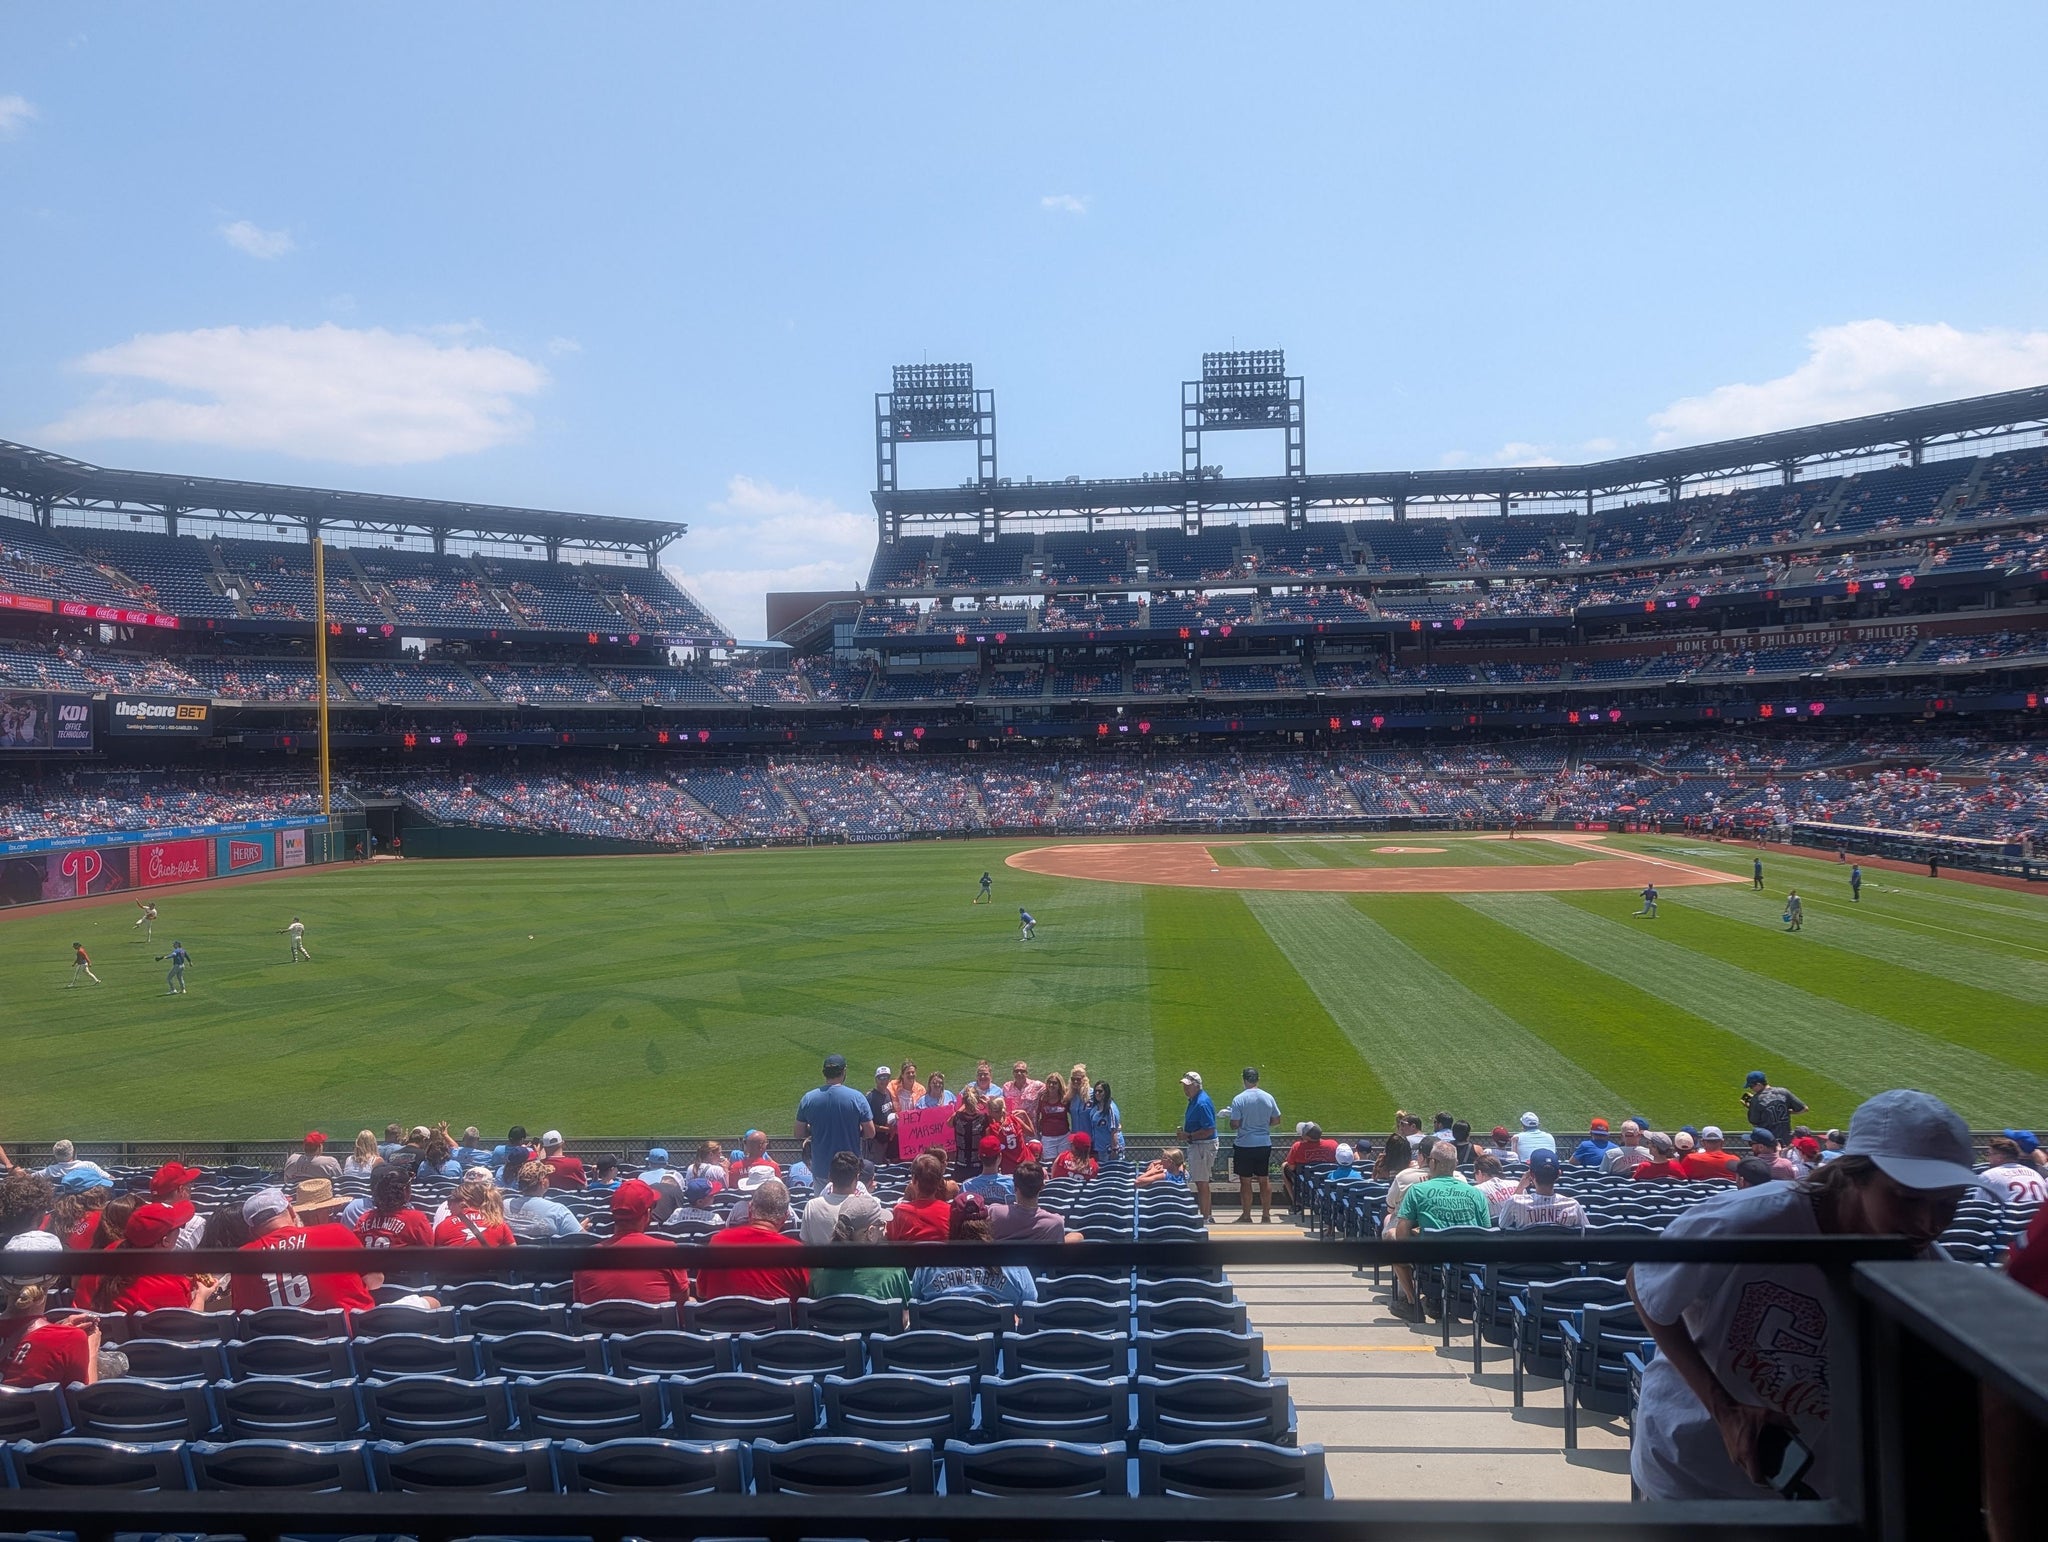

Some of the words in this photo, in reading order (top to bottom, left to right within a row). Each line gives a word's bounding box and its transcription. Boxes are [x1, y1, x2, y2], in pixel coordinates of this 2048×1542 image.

[1676, 640, 1707, 652] HOME
[1857, 625, 1919, 640] PHILLIES
[58, 705, 89, 721] KDI
[115, 701, 176, 717] theScore
[179, 706, 205, 718] BET
[57, 731, 90, 739] TECHNOLOGY
[65, 723, 82, 731] OFFICE
[143, 830, 168, 838] Independence
[849, 833, 887, 842] GRUNGO
[285, 838, 304, 849] WM
[148, 847, 200, 880] Chick-fil-A
[903, 1110, 923, 1124] HEY
[1766, 1103, 1788, 1123] 12
[909, 1122, 944, 1139] MARSHY
[1006, 1134, 1017, 1149] 5
[2009, 1181, 2047, 1202] 20
[1527, 1208, 1568, 1224] TURNER
[262, 1233, 308, 1250] RSH
[932, 1267, 1007, 1292] SCHWARBER
[261, 1273, 311, 1307] 16
